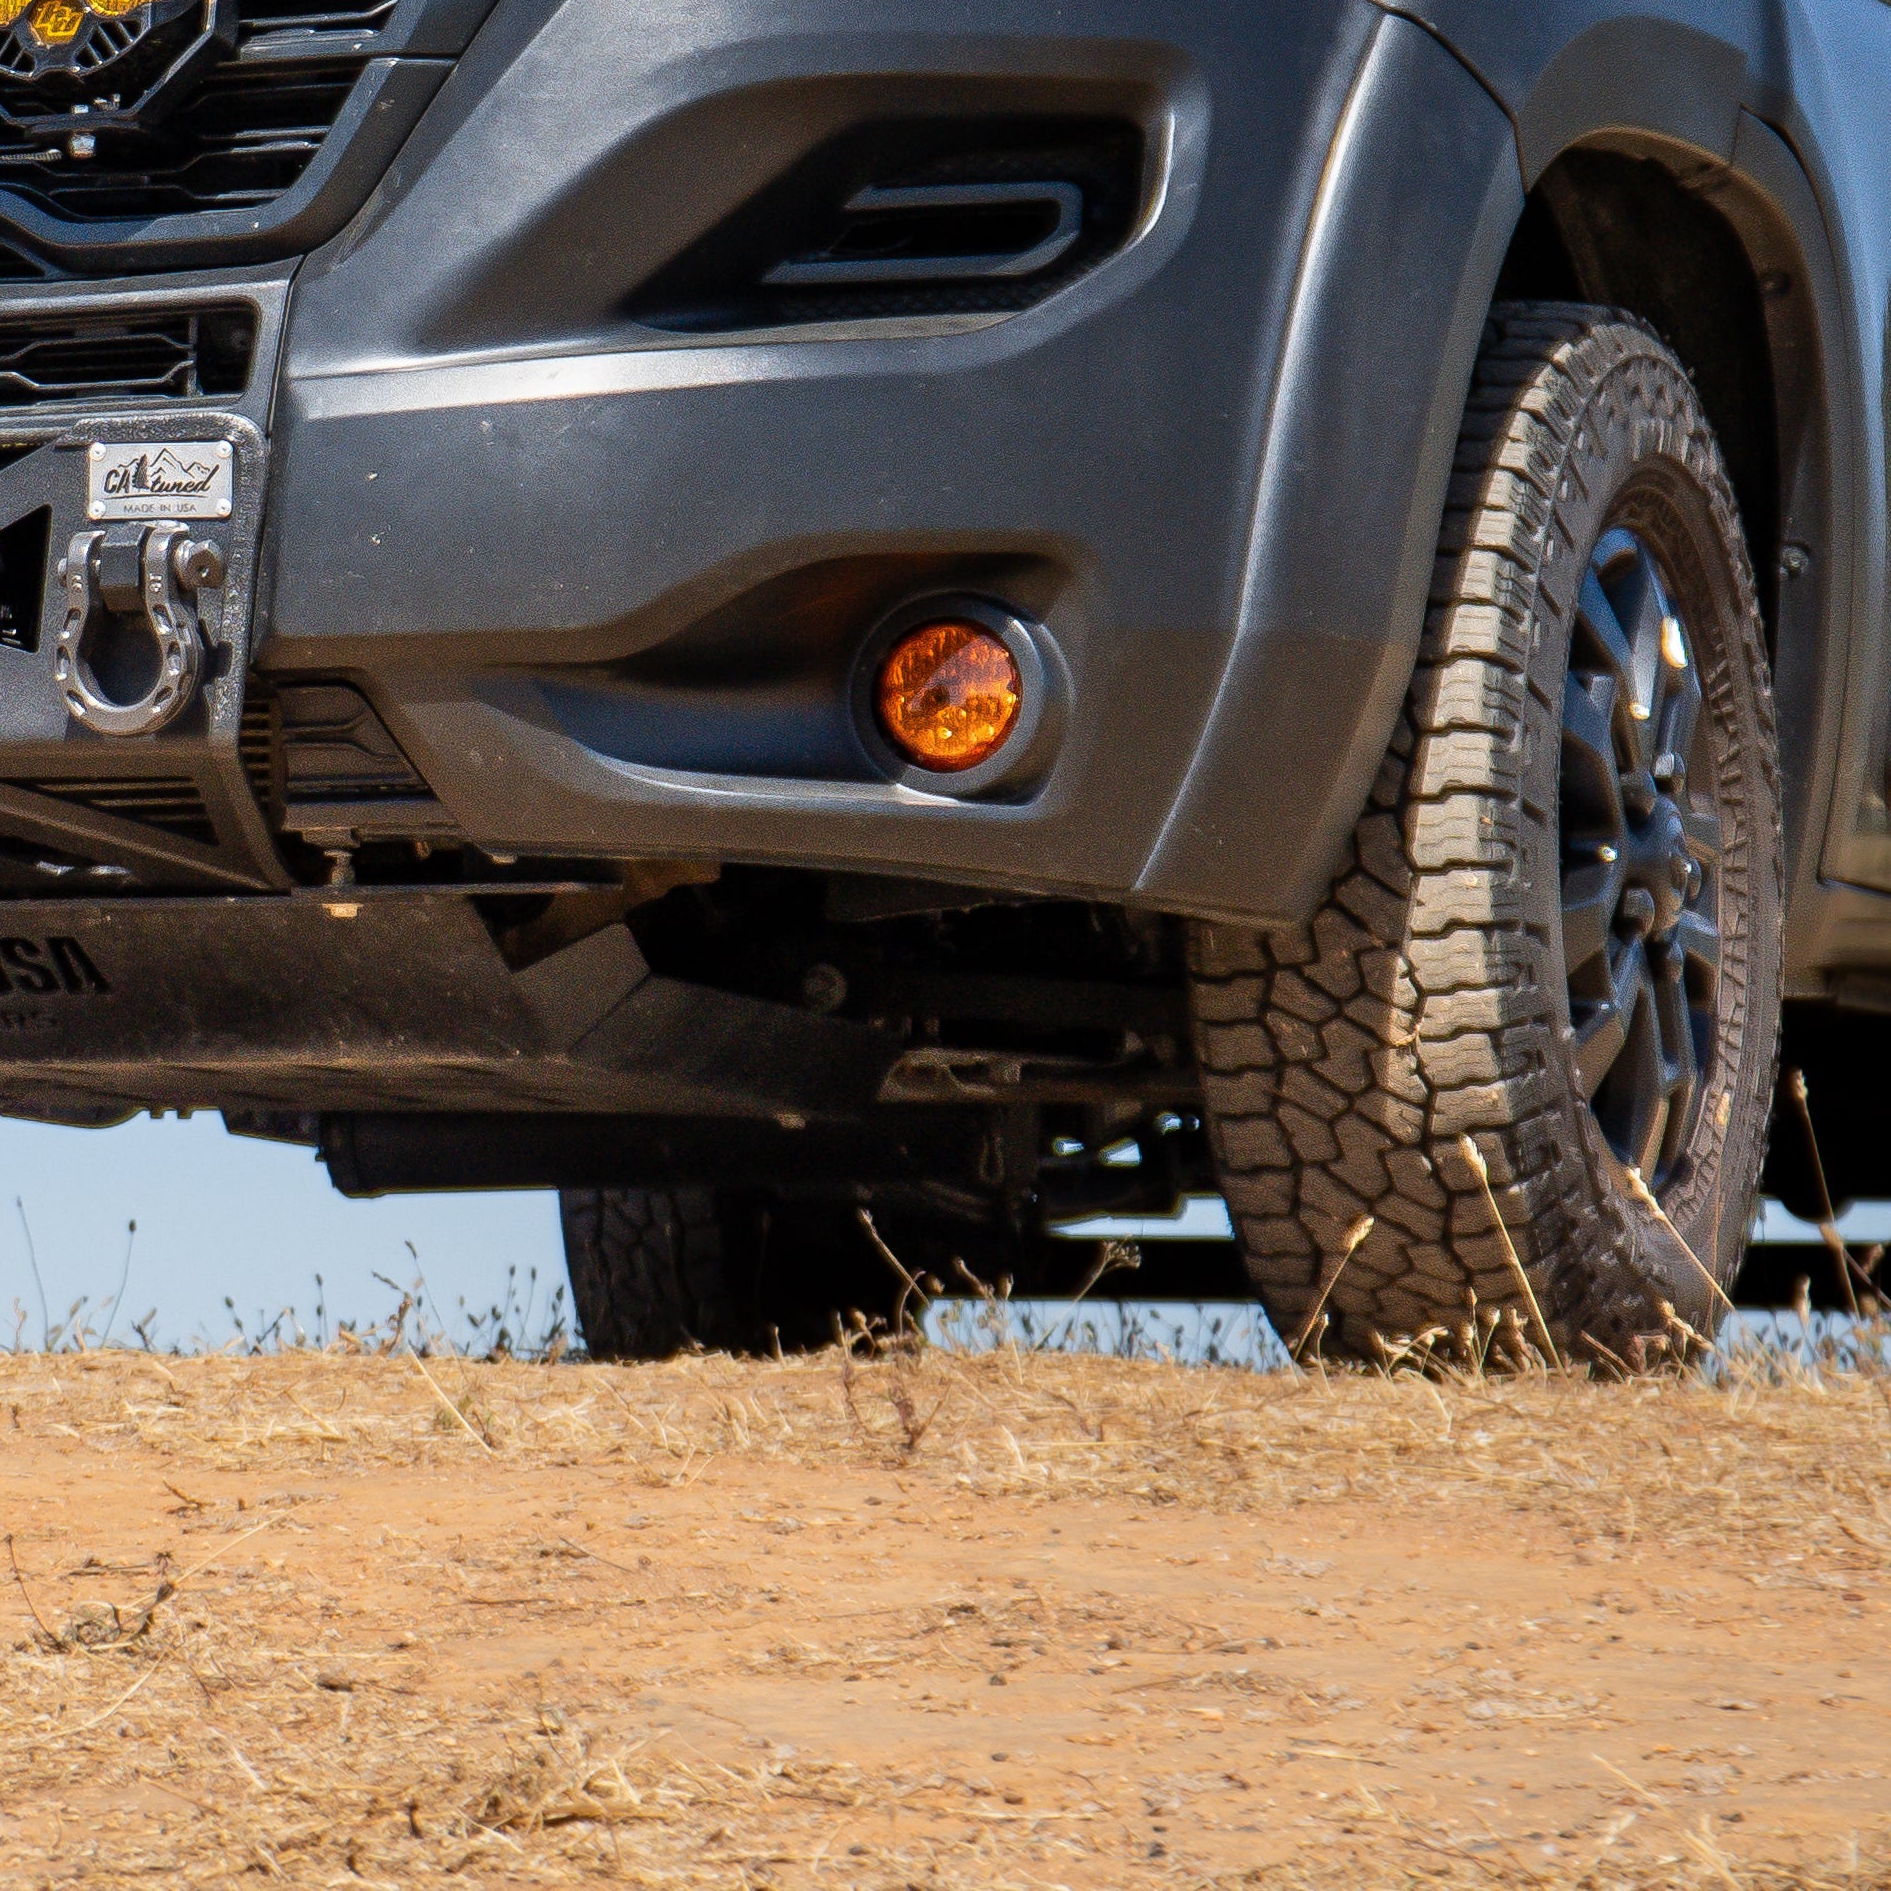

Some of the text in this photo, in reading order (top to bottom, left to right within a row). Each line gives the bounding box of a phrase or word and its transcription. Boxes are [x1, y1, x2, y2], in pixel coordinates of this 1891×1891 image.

[150, 464, 220, 493] tuned
[123, 503, 197, 513] MADE IN USA
